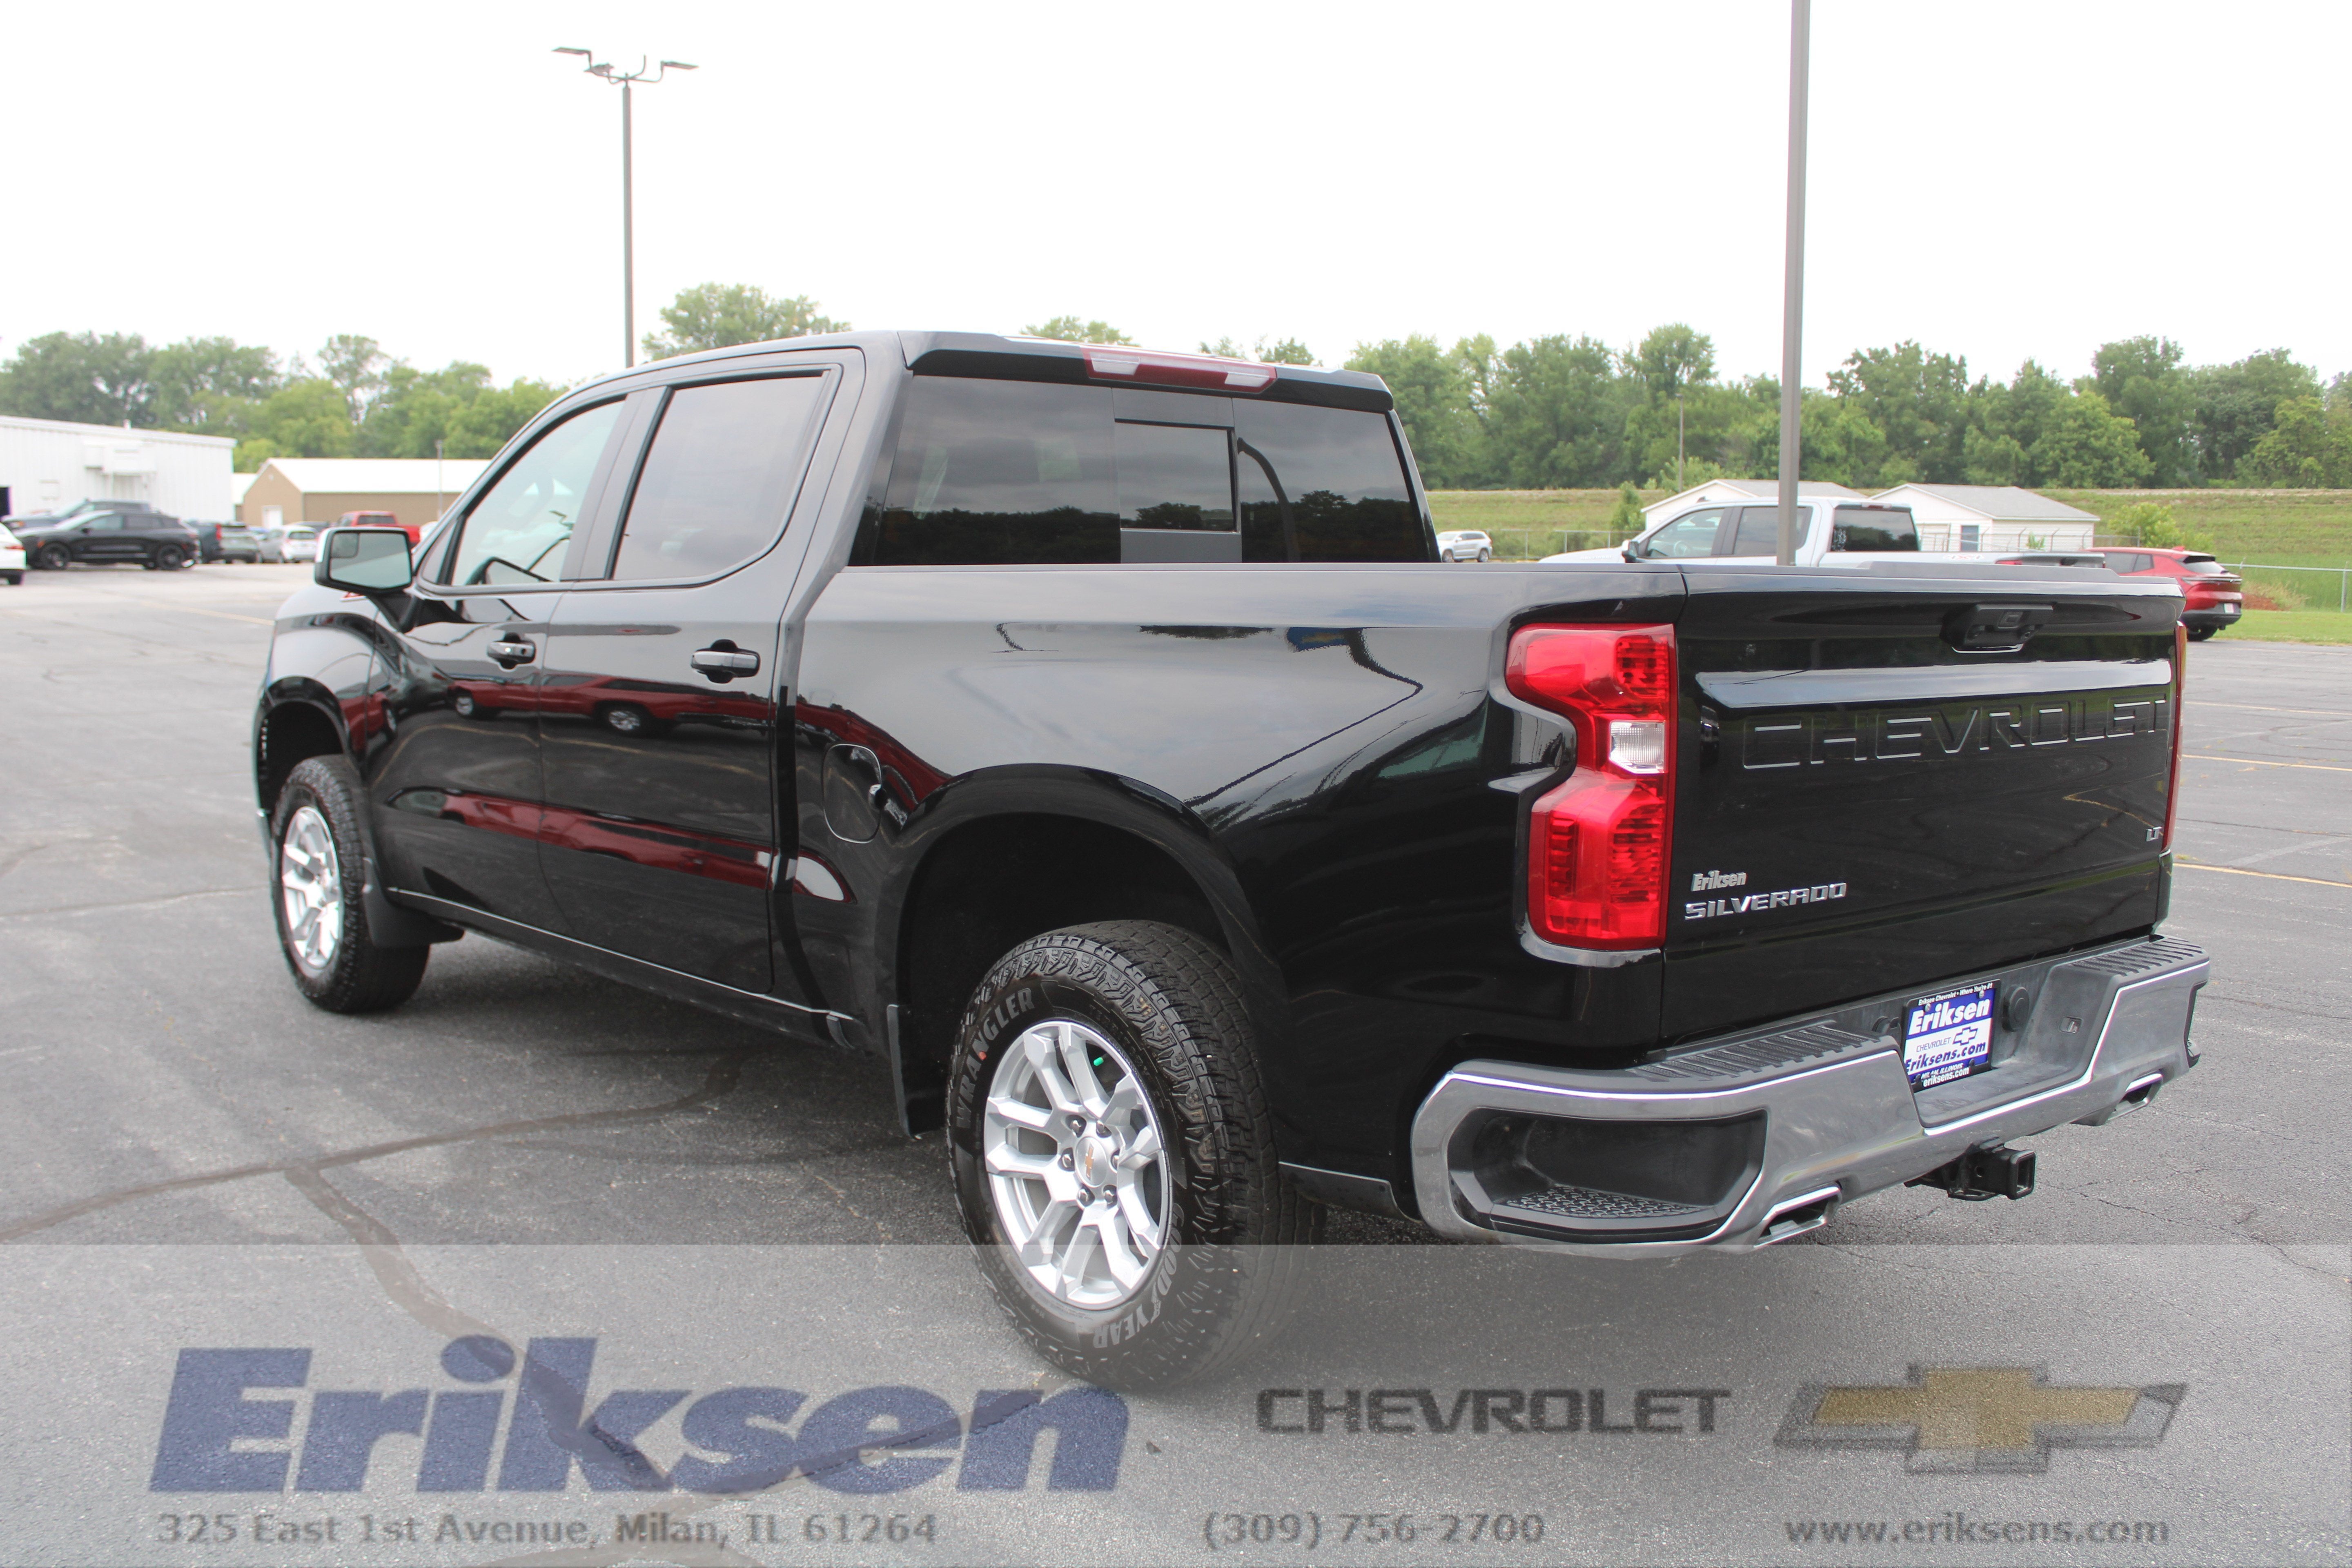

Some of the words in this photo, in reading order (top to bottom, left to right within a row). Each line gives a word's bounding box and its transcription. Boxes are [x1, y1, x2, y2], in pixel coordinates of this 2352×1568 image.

[1743, 693, 2167, 770] CHEVROLET
[2146, 826, 2163, 842] LT
[1690, 869, 1747, 892] Eriksen
[1684, 882, 1847, 920] SILVERADO
[1918, 997, 1935, 1006] Eriksen
[1935, 991, 1956, 1002] Chevrolet
[1908, 999, 1990, 1035] Eriksen
[957, 987, 1035, 1129] WRANGLER
[1905, 1042, 1986, 1073] Eriksens.com
[1916, 1037, 1951, 1053] CHEVROLET
[1923, 1067, 1969, 1087] eriksens.com
[1093, 1203, 1184, 1348] GOODYEAR
